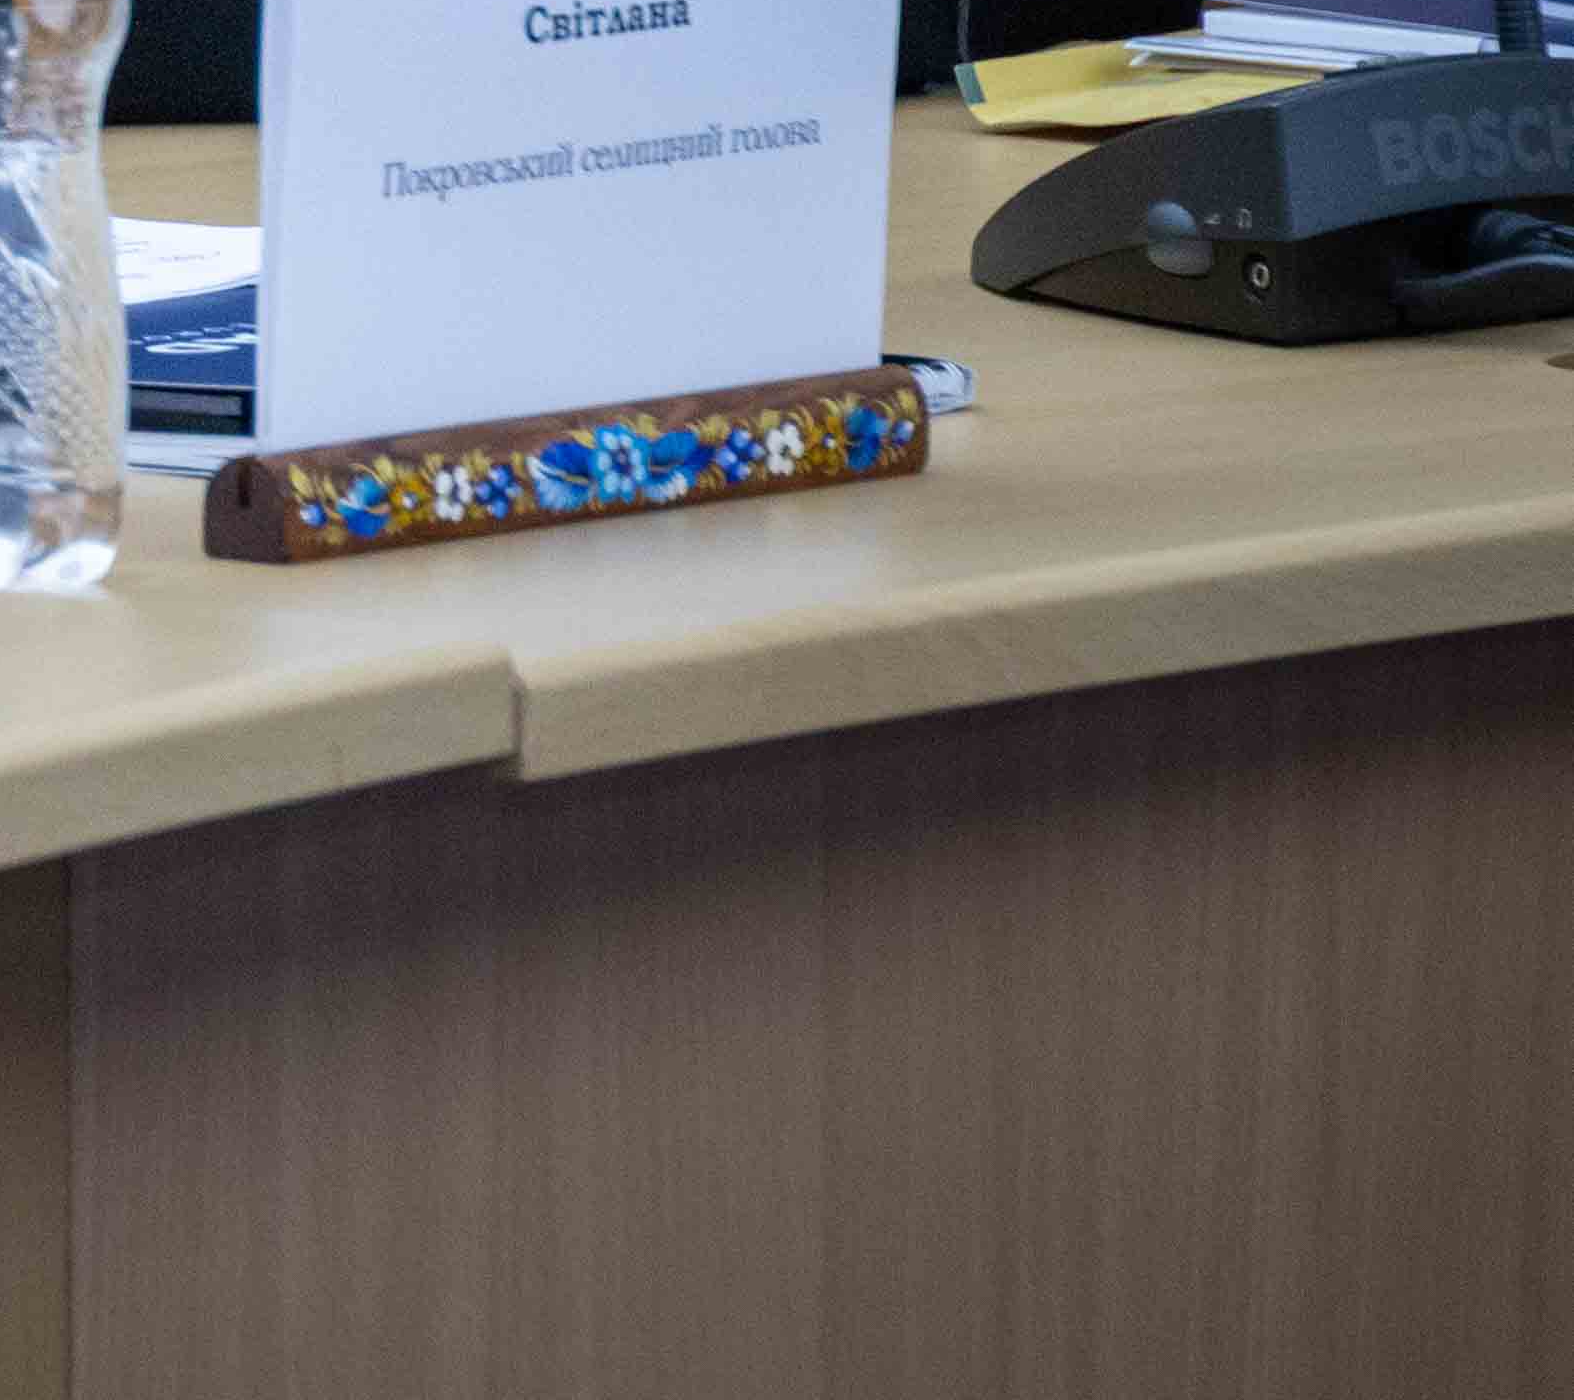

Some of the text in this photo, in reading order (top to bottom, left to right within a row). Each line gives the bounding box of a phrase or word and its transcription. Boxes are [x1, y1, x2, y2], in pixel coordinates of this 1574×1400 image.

[381, 118, 823, 202] Покровський селищний голова
